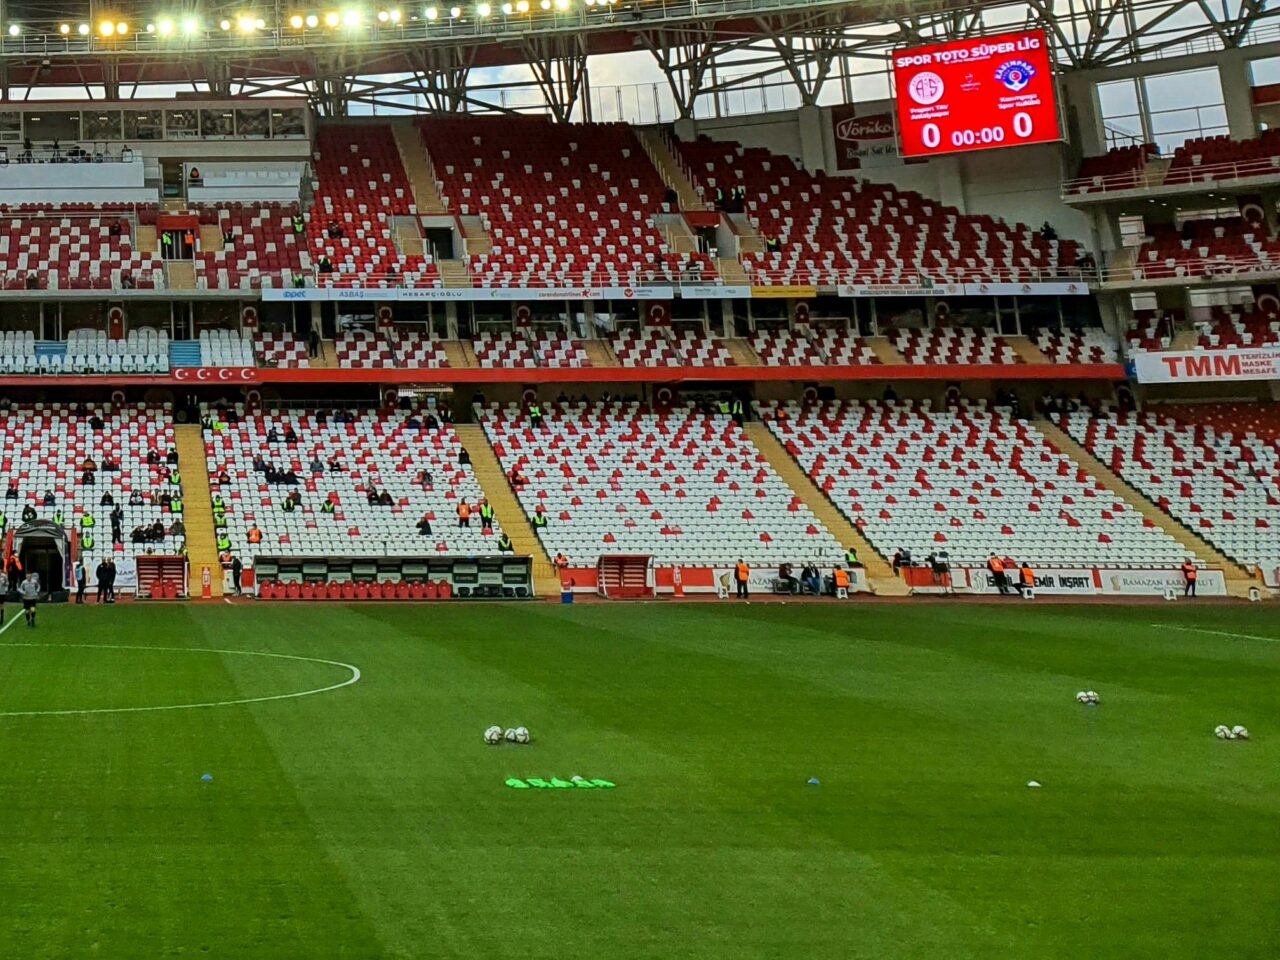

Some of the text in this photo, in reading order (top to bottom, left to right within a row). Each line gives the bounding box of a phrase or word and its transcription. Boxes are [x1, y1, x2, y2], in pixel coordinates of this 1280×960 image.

[896, 53, 932, 67] SPOR
[932, 49, 970, 63] TOTO
[970, 42, 1016, 57] SÜPER
[1018, 37, 1041, 50] LİG
[922, 123, 1005, 148] 0 00:00
[1013, 112, 1033, 138] 0
[1161, 354, 1242, 377] TMM
[1058, 574, 1090, 588] İNŞAAT
[1122, 577, 1214, 587] RAMAZAN KARALUT
